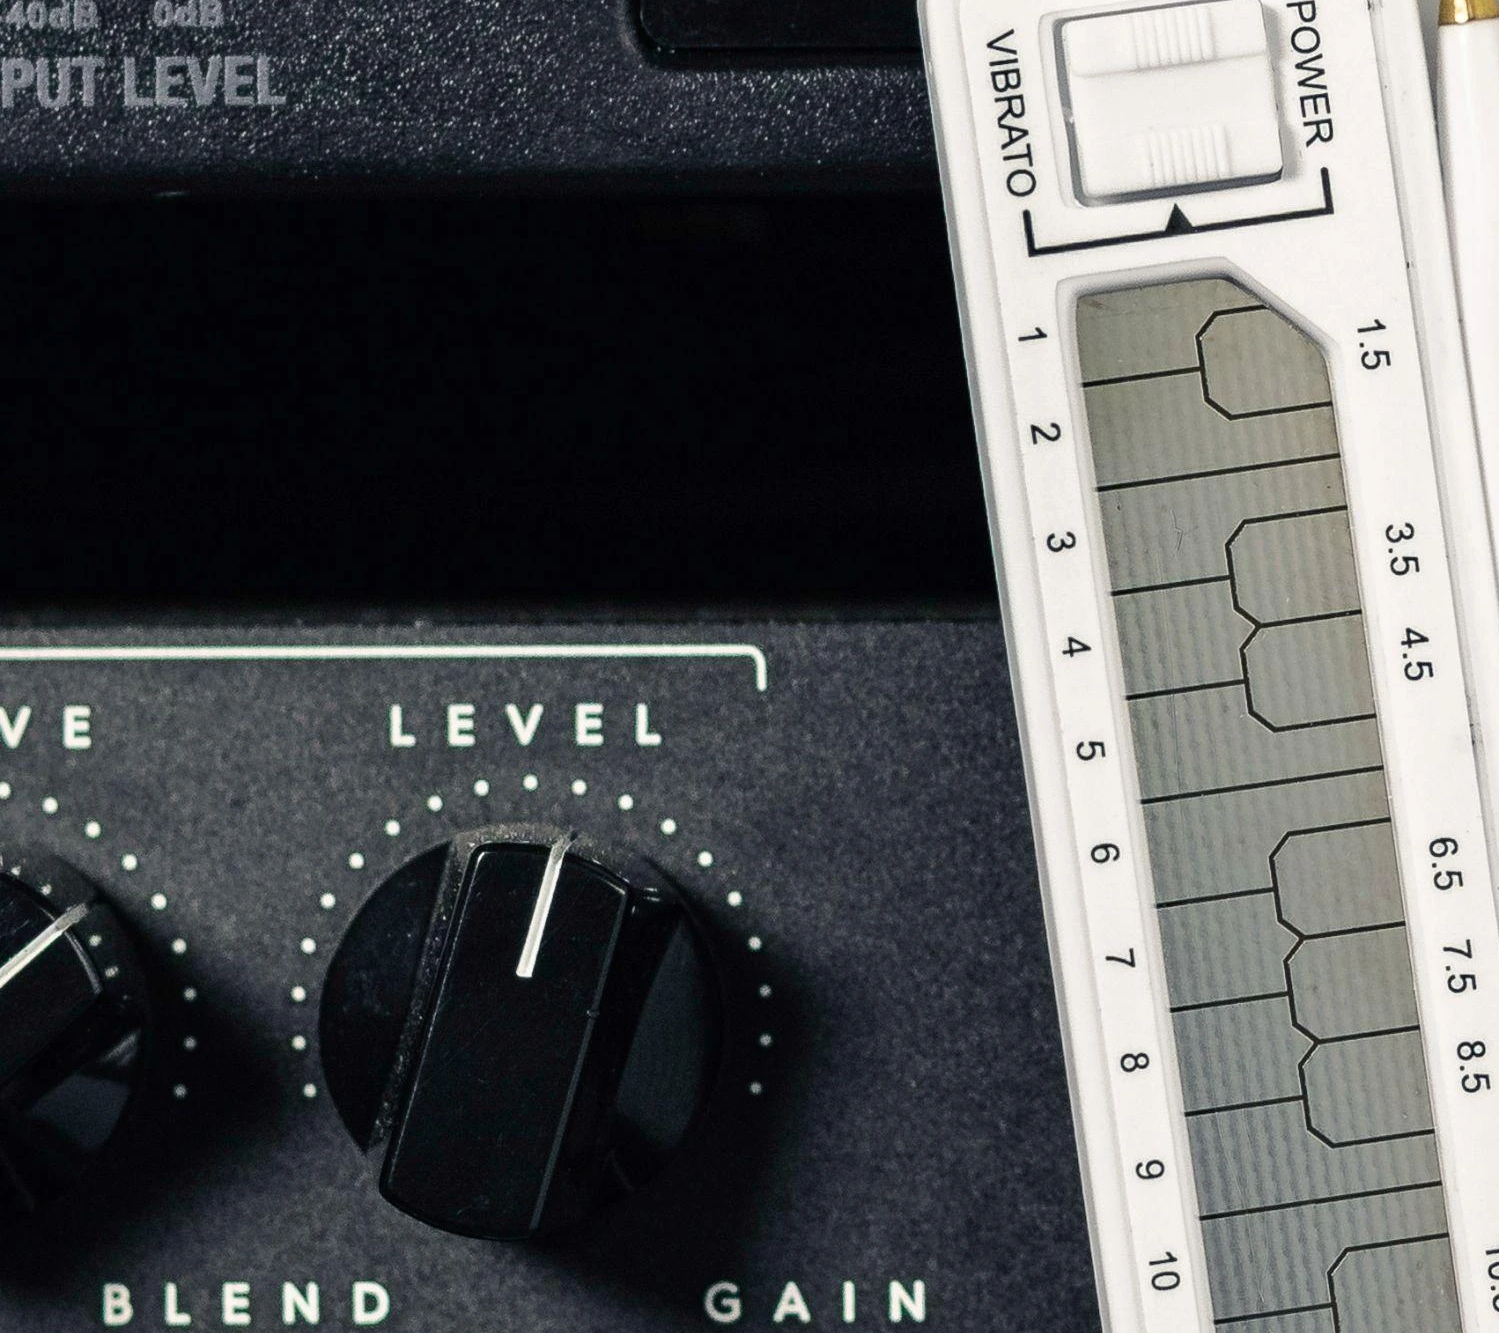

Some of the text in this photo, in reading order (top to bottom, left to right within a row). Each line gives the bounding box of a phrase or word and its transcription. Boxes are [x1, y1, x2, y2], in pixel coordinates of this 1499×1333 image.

[1, 54, 288, 108] PUT LEVEL
[1286, 0, 1334, 147] POWER
[986, 29, 1037, 198] VIBRATO
[1018, 326, 1048, 342] 1
[1357, 318, 1392, 371] 1.5
[1030, 422, 1062, 445] 2
[1046, 531, 1077, 553] 3
[1385, 522, 1420, 576] 3.5
[1062, 636, 1092, 658] 4
[1400, 627, 1434, 682] 4.5
[0, 705, 92, 749] VE
[390, 703, 662, 747] LEVEL
[1075, 740, 1106, 762] 5
[1090, 842, 1121, 864] 6
[1428, 837, 1464, 891] 6.5
[1105, 947, 1136, 968] 7
[1442, 939, 1477, 994] 7.5
[1119, 1052, 1150, 1073] 8
[1456, 1040, 1491, 1094] 8.5
[1135, 1159, 1165, 1180] 9
[1148, 1251, 1181, 1292] 10
[104, 1281, 390, 1325] BLEND
[706, 1279, 926, 1323] GAIN
